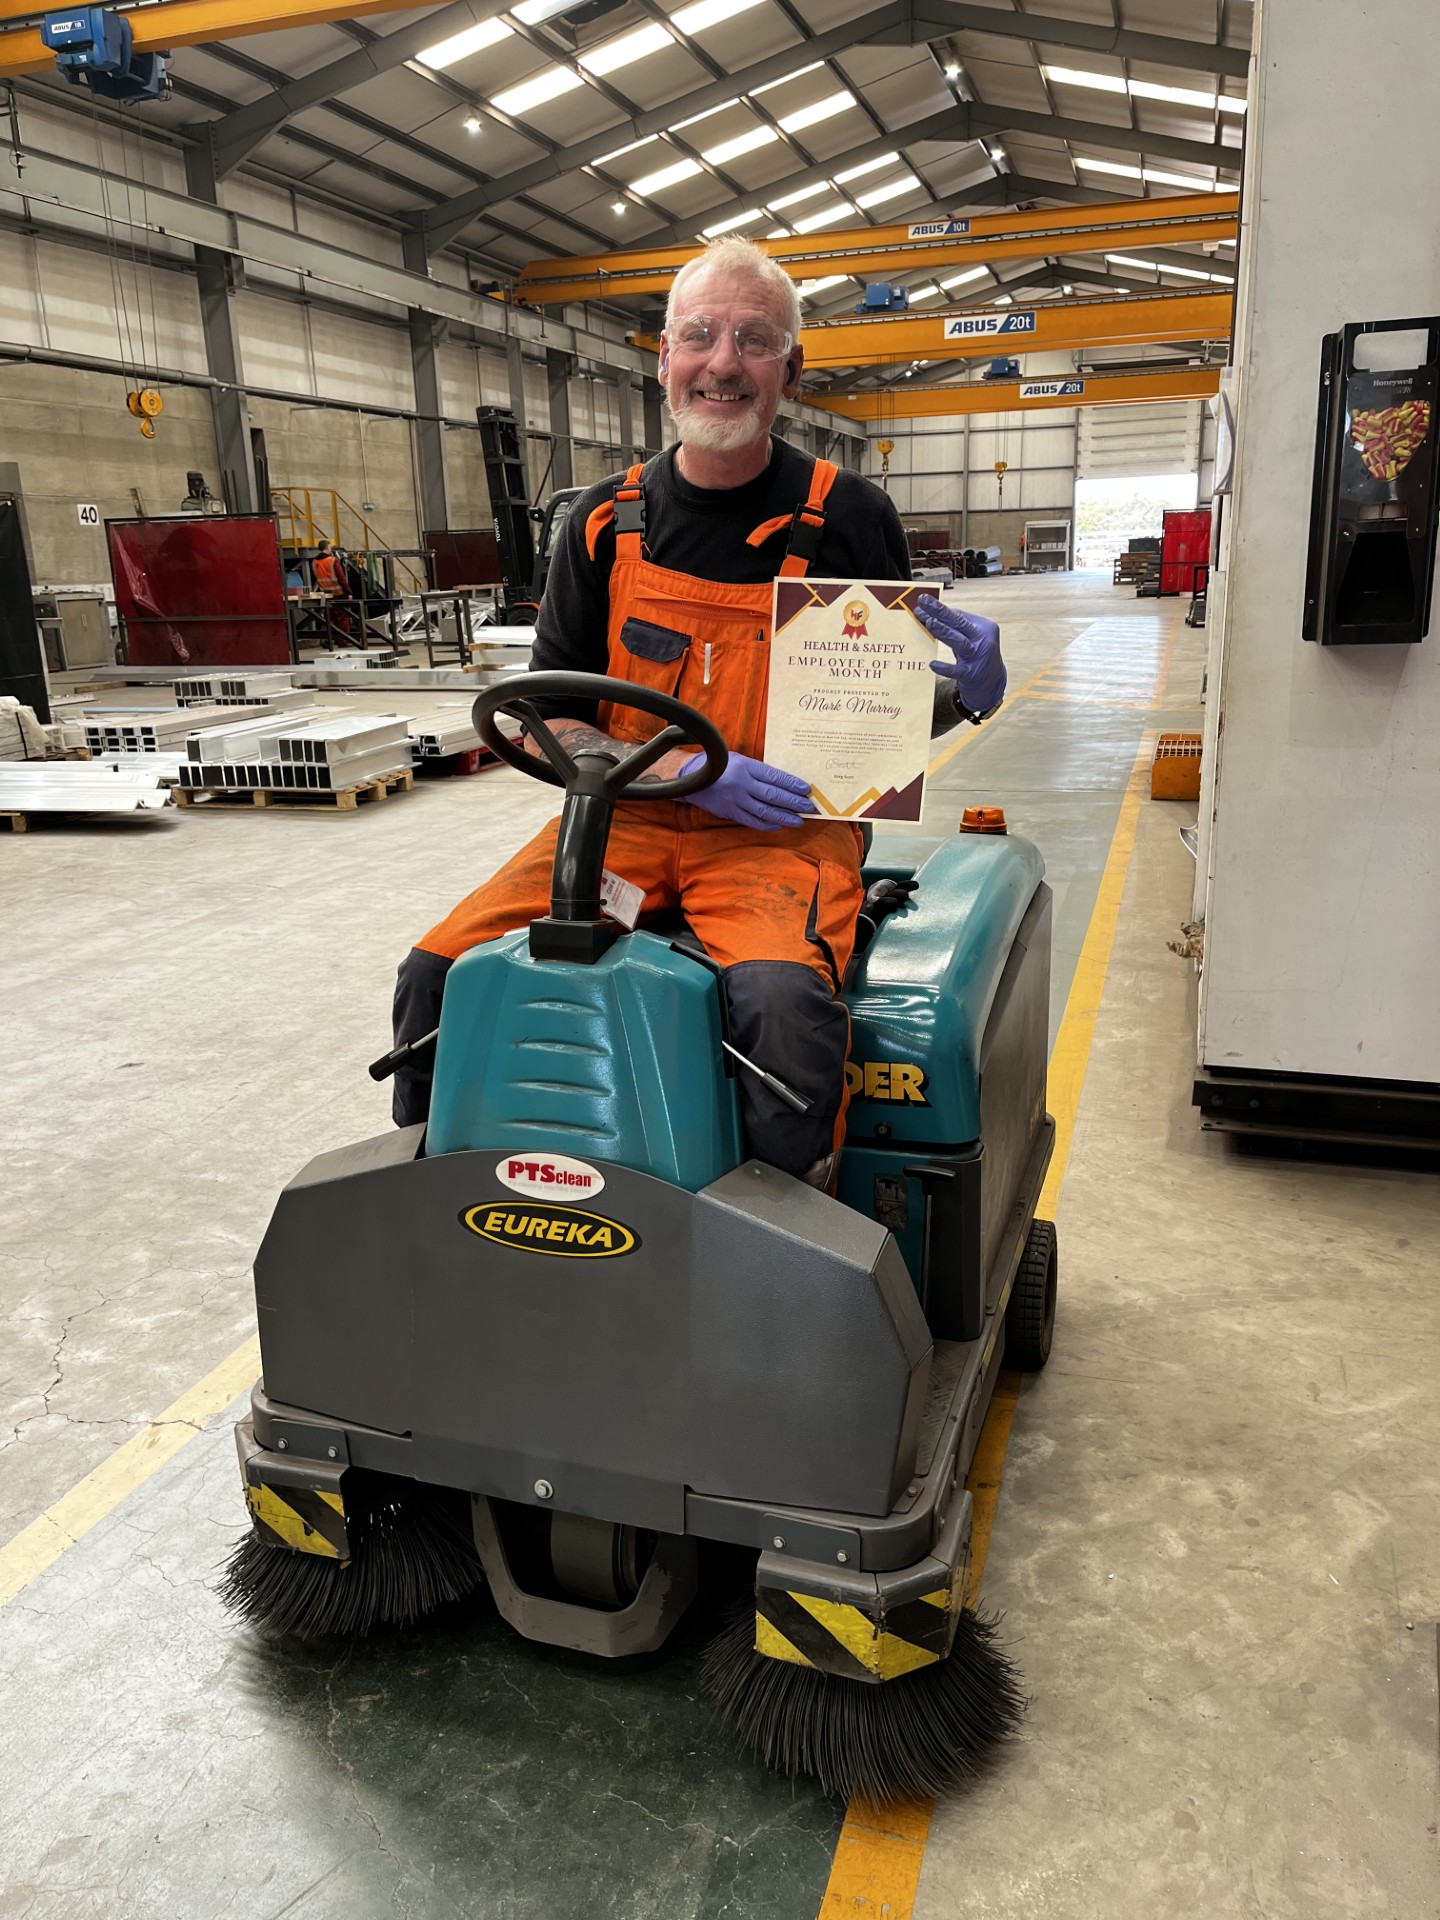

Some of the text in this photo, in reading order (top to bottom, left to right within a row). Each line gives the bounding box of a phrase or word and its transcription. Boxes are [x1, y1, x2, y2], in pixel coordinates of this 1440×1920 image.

[911, 221, 966, 236] ABUS 10t
[949, 315, 1031, 334] ABUS 20t
[1023, 381, 1081, 396] ABUS 20t
[1373, 377, 1414, 387] Honeywell
[81, 506, 98, 523] 40
[493, 517, 501, 542] TOYOTA
[804, 641, 906, 654] HEALTH & SAFETY
[788, 656, 926, 671] EMPLOYEE OF THE
[828, 667, 882, 679] MONTH
[798, 694, 903, 720] Mark Murray
[544, 1184, 569, 1192] machine
[484, 1211, 613, 1249] EUREKA
